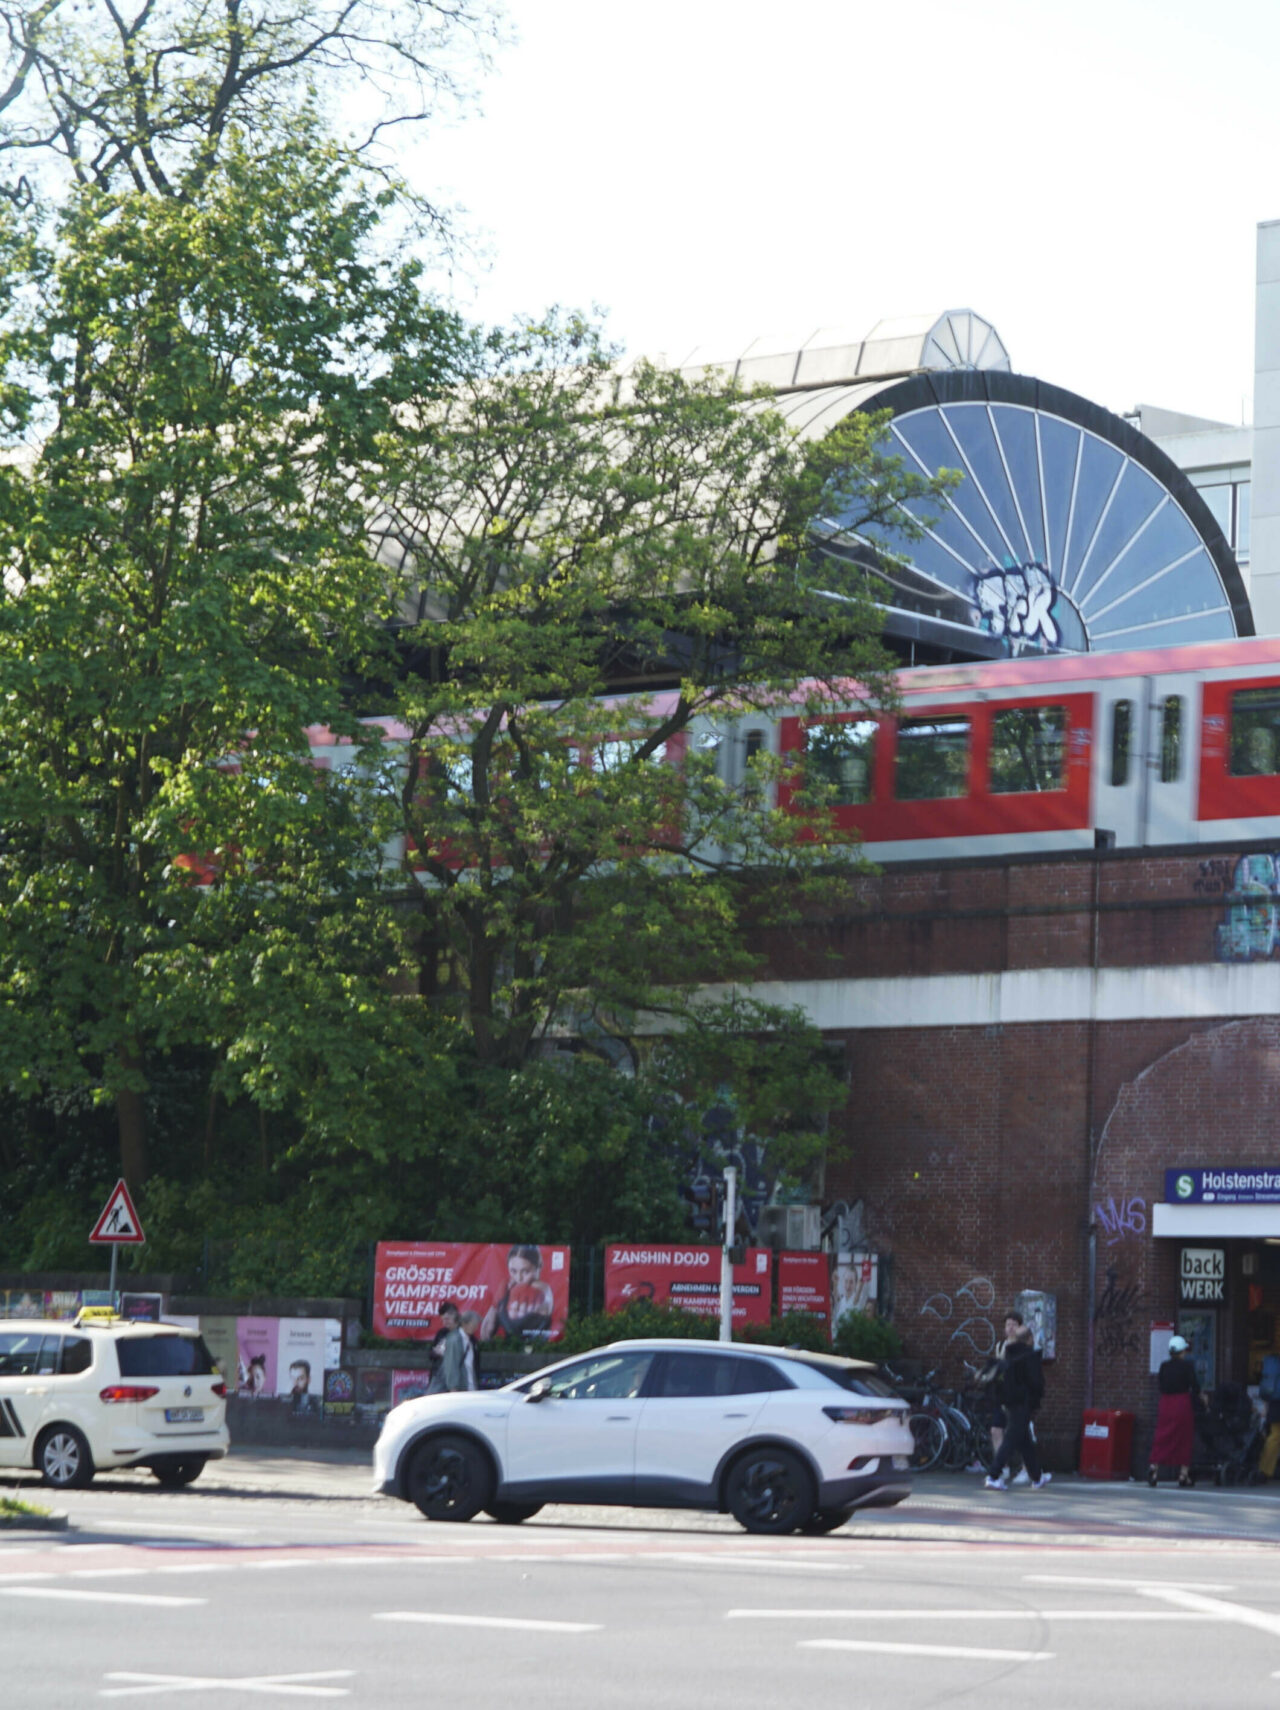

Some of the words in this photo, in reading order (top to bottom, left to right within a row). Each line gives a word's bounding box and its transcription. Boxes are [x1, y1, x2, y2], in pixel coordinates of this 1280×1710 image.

[1177, 1174, 1194, 1198] S
[612, 1250, 673, 1265] ZANSHIN
[673, 1251, 710, 1266] DOJO
[1182, 1252, 1223, 1275] back
[385, 1264, 453, 1282] GRÖSSTE
[384, 1284, 488, 1300] KAMPFSPORT
[1181, 1280, 1224, 1300] WERK
[384, 1301, 443, 1317] VIELFAL
